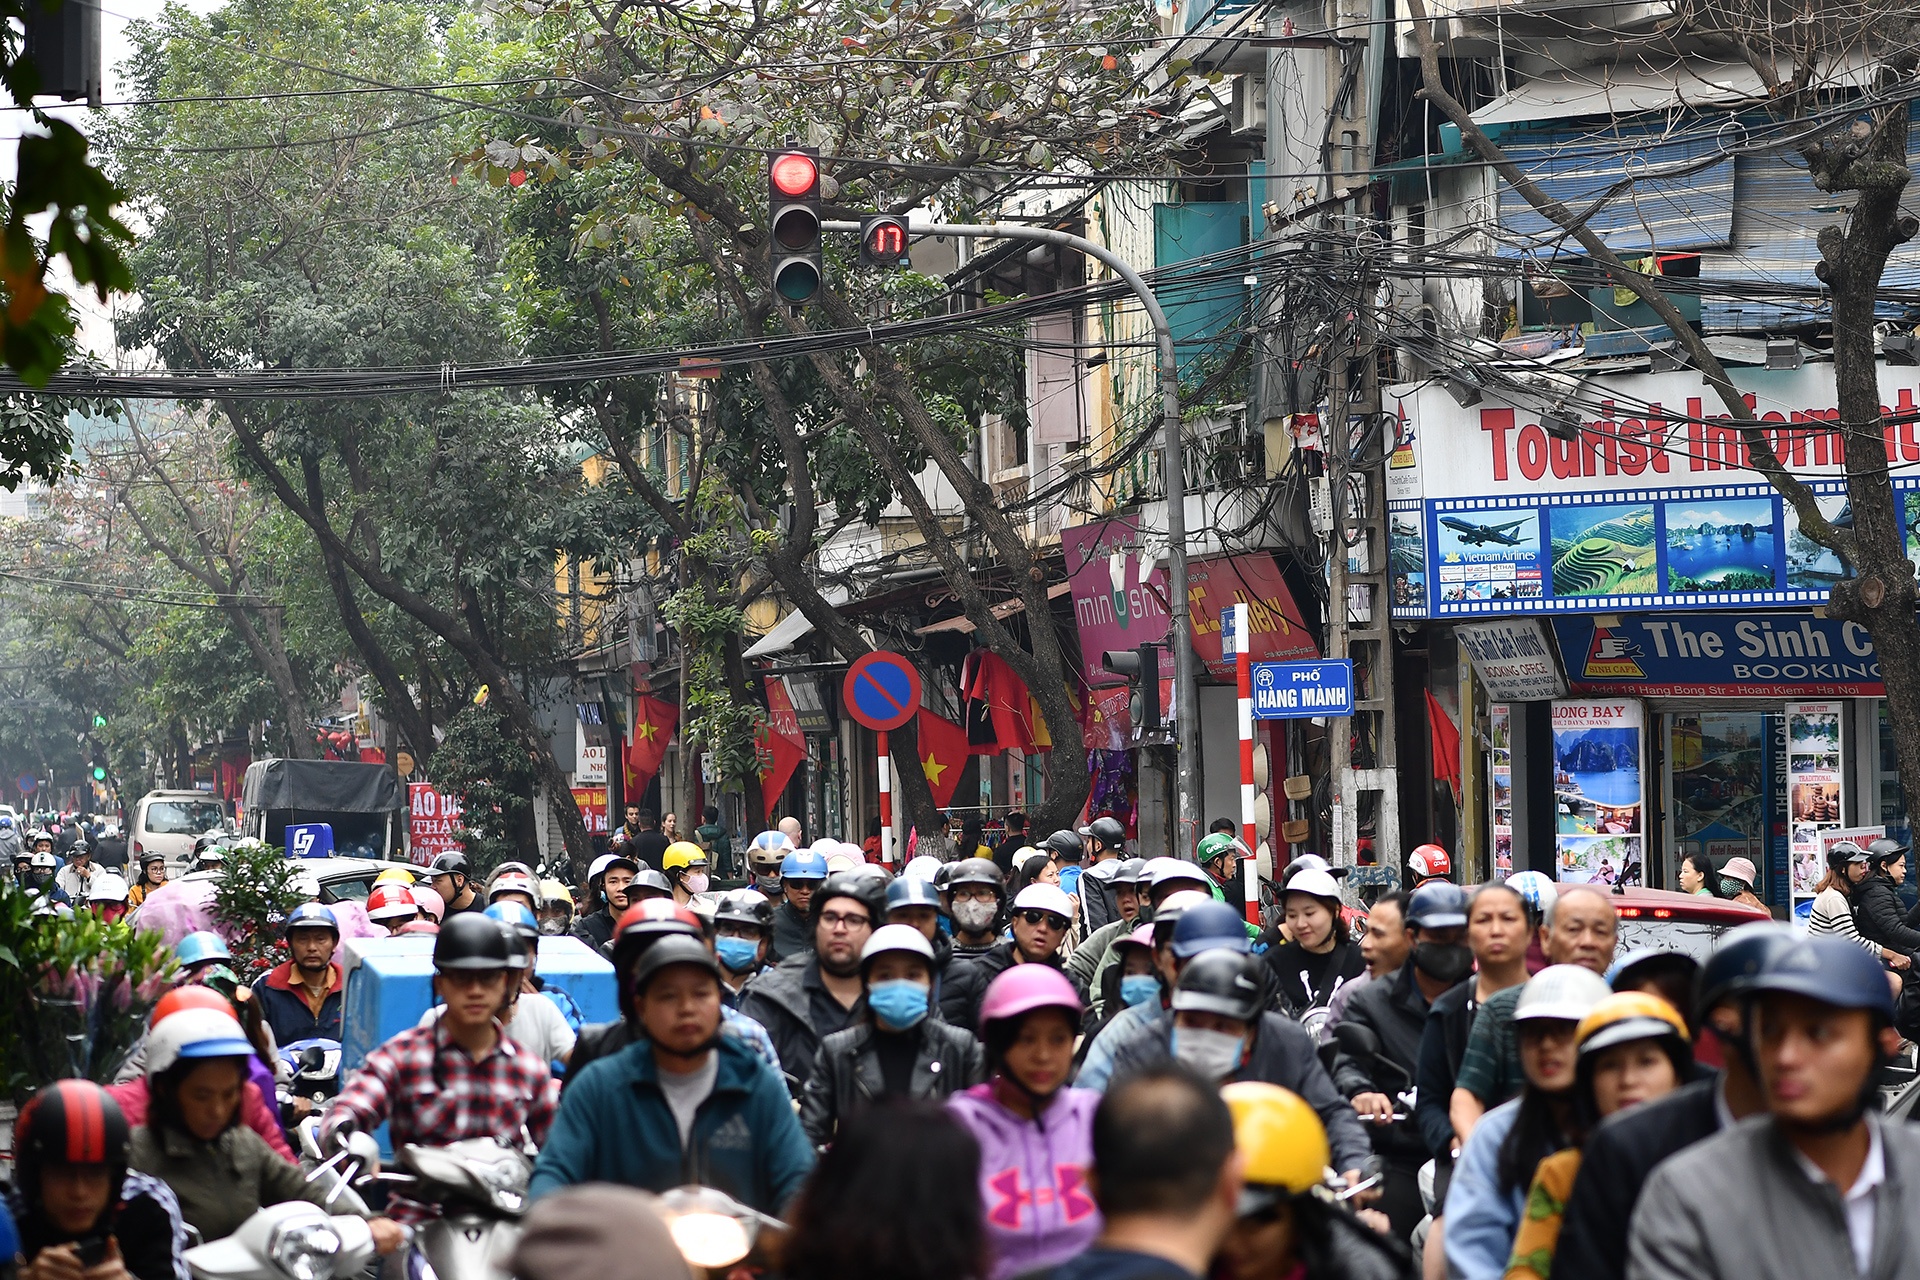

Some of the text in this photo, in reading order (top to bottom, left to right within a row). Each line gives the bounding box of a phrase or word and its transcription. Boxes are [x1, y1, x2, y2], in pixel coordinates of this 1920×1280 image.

[877, 227, 902, 253] 17
[1479, 400, 1670, 481] Tourist
[1462, 550, 1536, 562] Vietnam Airlines
[1458, 633, 1483, 661] The
[1473, 631, 1501, 661] Sinh
[1506, 626, 1546, 658] Tourist
[1641, 621, 1725, 658] The
[1734, 620, 1831, 658] Sinh
[1291, 667, 1322, 682] PHỐ
[1483, 662, 1548, 678] BOOKING OFFICE
[1588, 665, 1638, 674] SINH CAFE
[1258, 684, 1347, 709] HÀNG MÀNH
[1590, 685, 1860, 696] Add: 18 Hang Bong Str Hoan Kiem Ha Noi
[1592, 706, 1626, 718] BAY
[1775, 750, 1788, 784] SINH
[412, 786, 436, 817] ÁO
[1775, 788, 1788, 816] THE
[421, 837, 456, 846] SALE
[1206, 841, 1223, 854] Grab
[1709, 844, 1761, 856] Hotel Reservion
[412, 845, 436, 865] 20%
